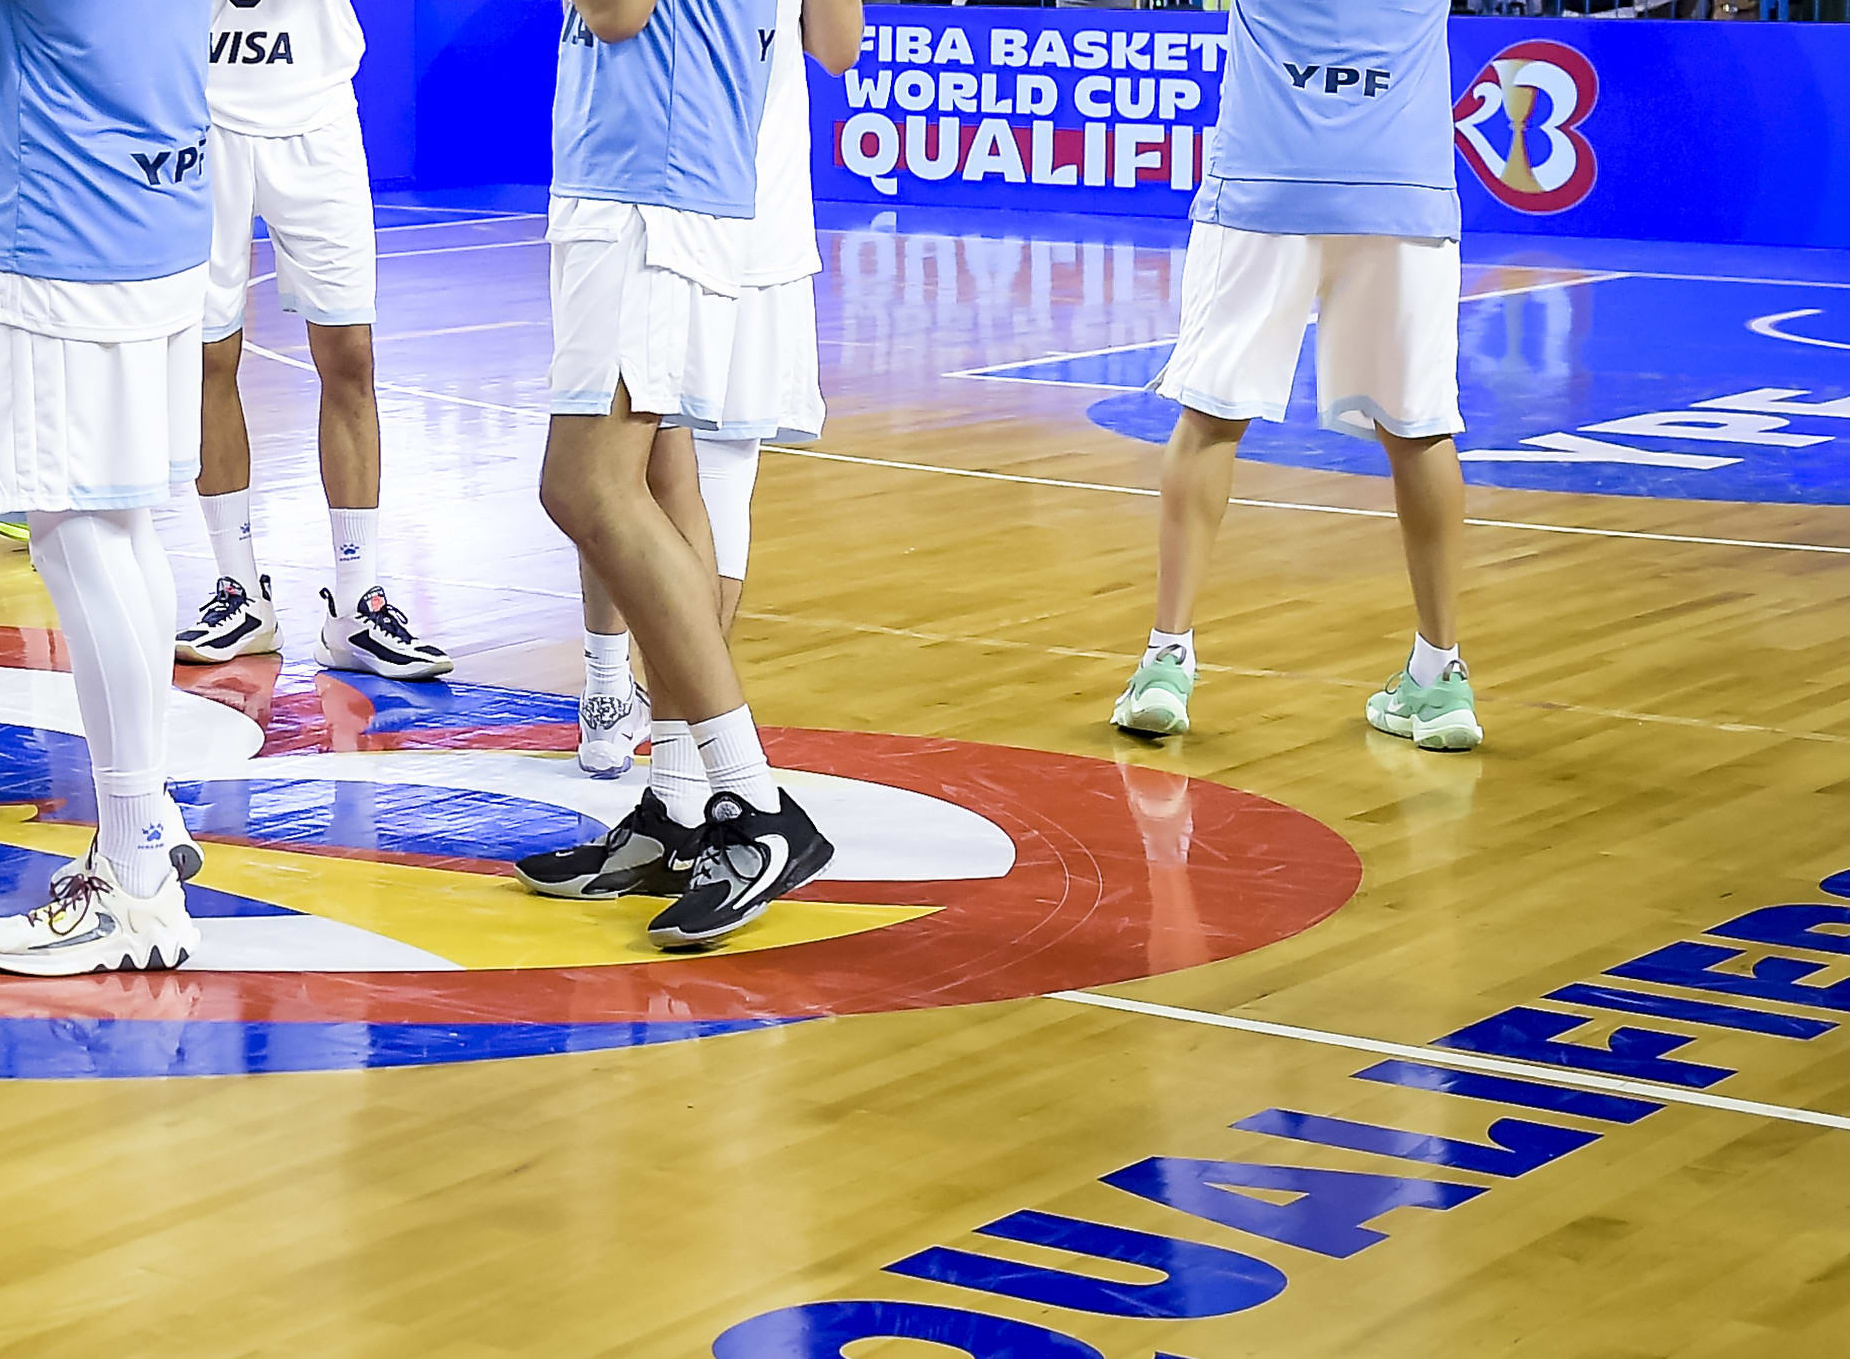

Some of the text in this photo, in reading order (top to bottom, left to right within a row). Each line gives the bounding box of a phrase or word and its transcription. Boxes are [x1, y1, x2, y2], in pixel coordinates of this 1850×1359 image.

[845, 70, 1201, 120] WORLD CUP
[1282, 62, 1391, 98] YPF
[840, 112, 1220, 195] QUALIFI
